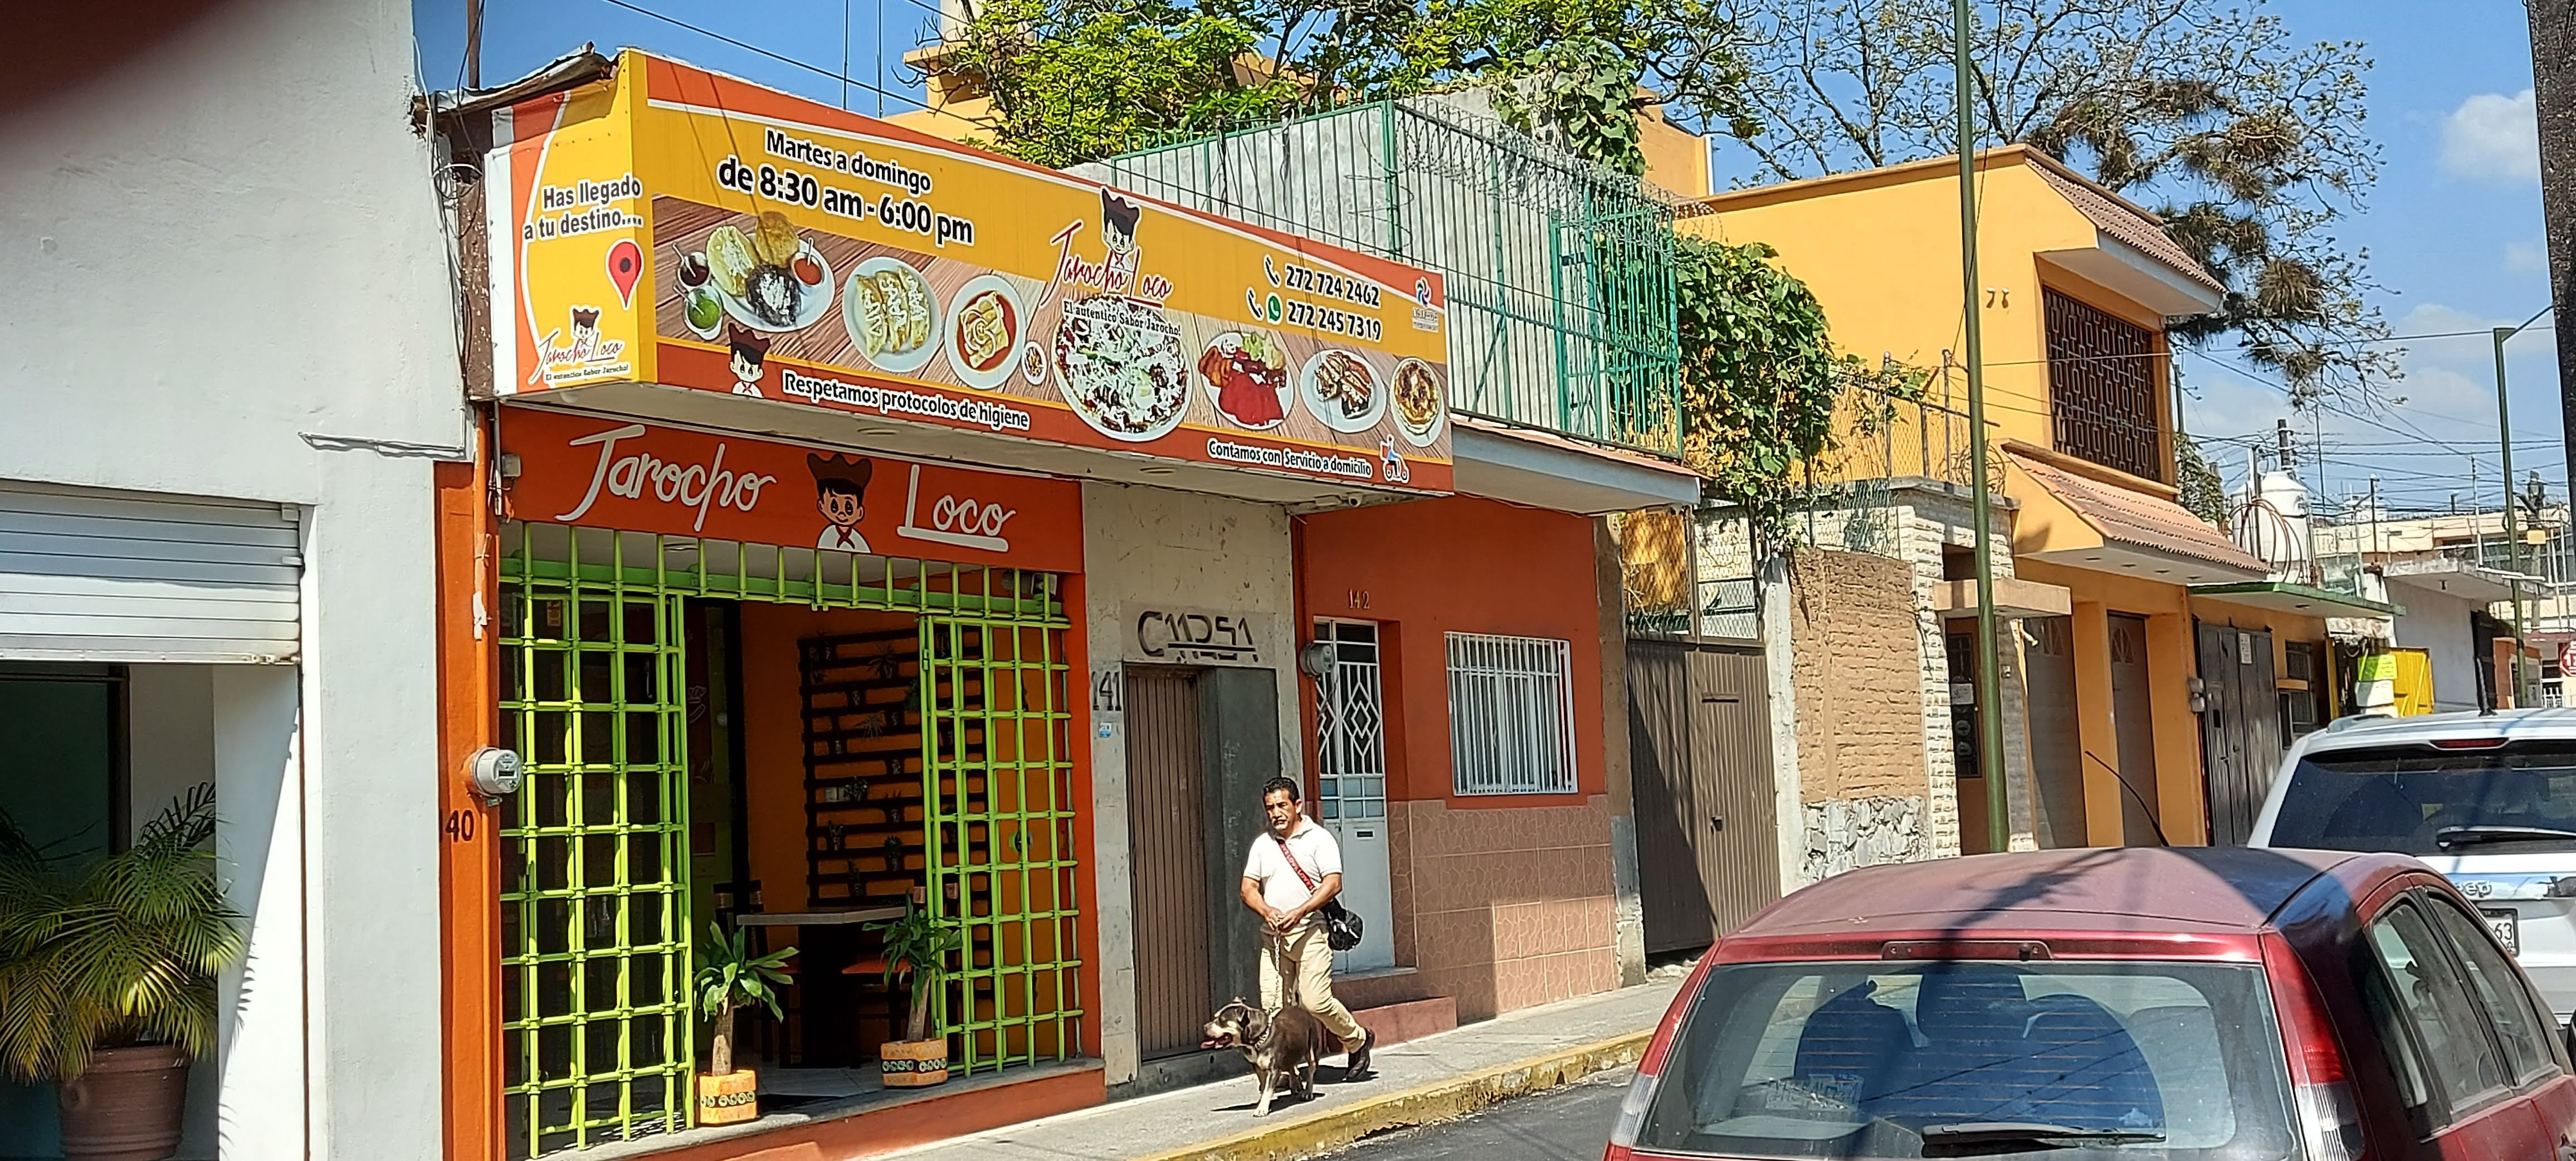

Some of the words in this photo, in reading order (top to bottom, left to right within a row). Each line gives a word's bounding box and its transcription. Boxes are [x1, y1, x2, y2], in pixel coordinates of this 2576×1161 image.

[767, 130, 832, 167] Martes
[836, 157, 847, 170] a
[852, 155, 931, 194] domingo
[544, 188, 574, 208] Has
[580, 175, 640, 204] llegado
[719, 158, 753, 191] de
[760, 167, 817, 206] 8:30
[825, 189, 862, 217] am
[880, 197, 931, 232] 6:00
[938, 216, 973, 244] pm
[524, 225, 533, 240] a
[539, 219, 554, 237] tu
[1040, 222, 1129, 306] Jarocho
[1124, 248, 1172, 308] Loco
[1286, 266, 1313, 293] 272
[1317, 272, 1343, 297] 724
[1346, 282, 1380, 306] 2462
[1063, 301, 1072, 314] El
[1120, 314, 1144, 328] Sabor
[1146, 318, 1180, 336] Jarocho!
[1289, 302, 1314, 326] 272
[1319, 308, 1344, 332] 245
[1348, 315, 1381, 340] 7319
[530, 330, 590, 381] Jarocho
[584, 332, 622, 363] Loco
[785, 373, 878, 402] Respetamos
[882, 393, 957, 415] protocolos
[960, 403, 977, 418] de
[979, 405, 1029, 428] higiene
[1208, 441, 1261, 460] Contamos
[1263, 452, 1280, 464] con
[1285, 451, 1321, 469] Servicio
[1323, 460, 1329, 469] a
[1331, 458, 1372, 476] domicilio
[554, 424, 778, 531] Jarocho
[897, 464, 1017, 552] Loco
[1348, 588, 1370, 609] 142
[1091, 671, 1121, 711] 141
